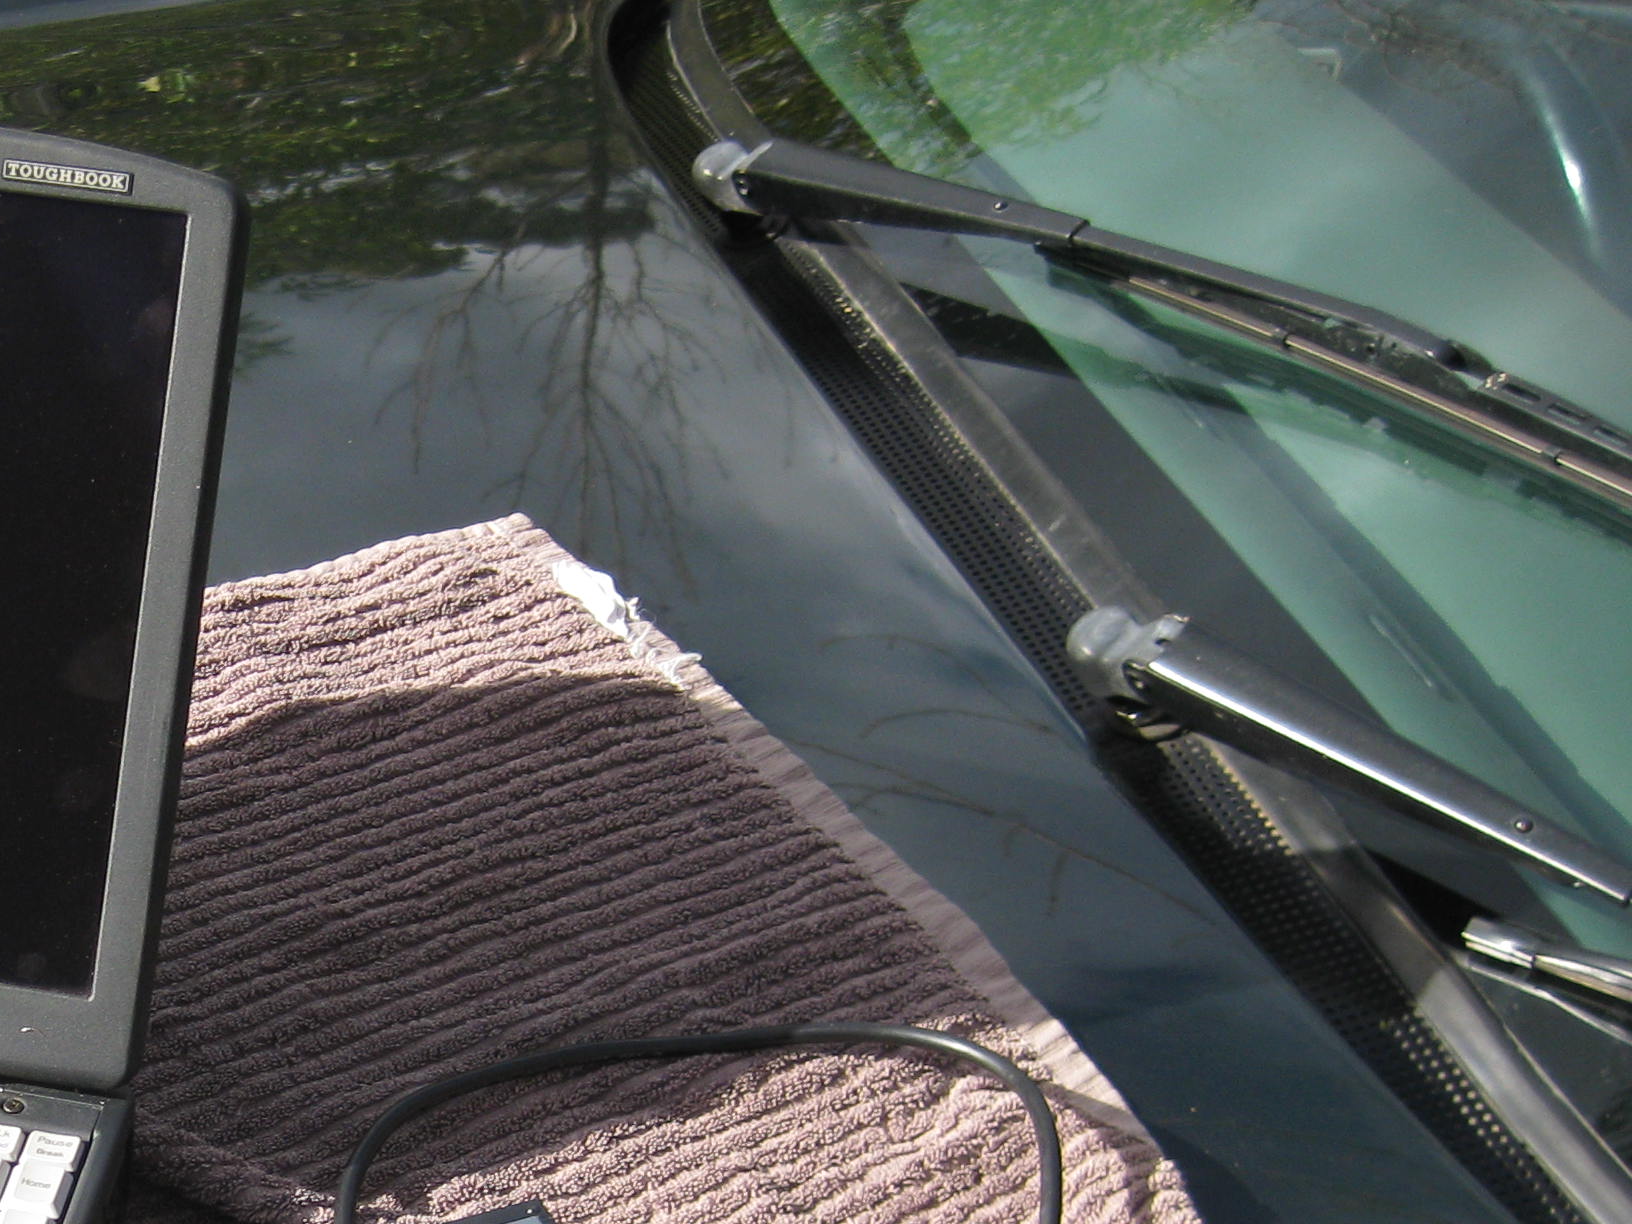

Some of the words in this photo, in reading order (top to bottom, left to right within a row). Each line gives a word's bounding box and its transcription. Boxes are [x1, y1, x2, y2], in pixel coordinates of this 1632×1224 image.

[7, 162, 126, 190] TOUGHBOOK
[36, 1135, 74, 1148] Pause
[20, 1175, 52, 1190] Home
